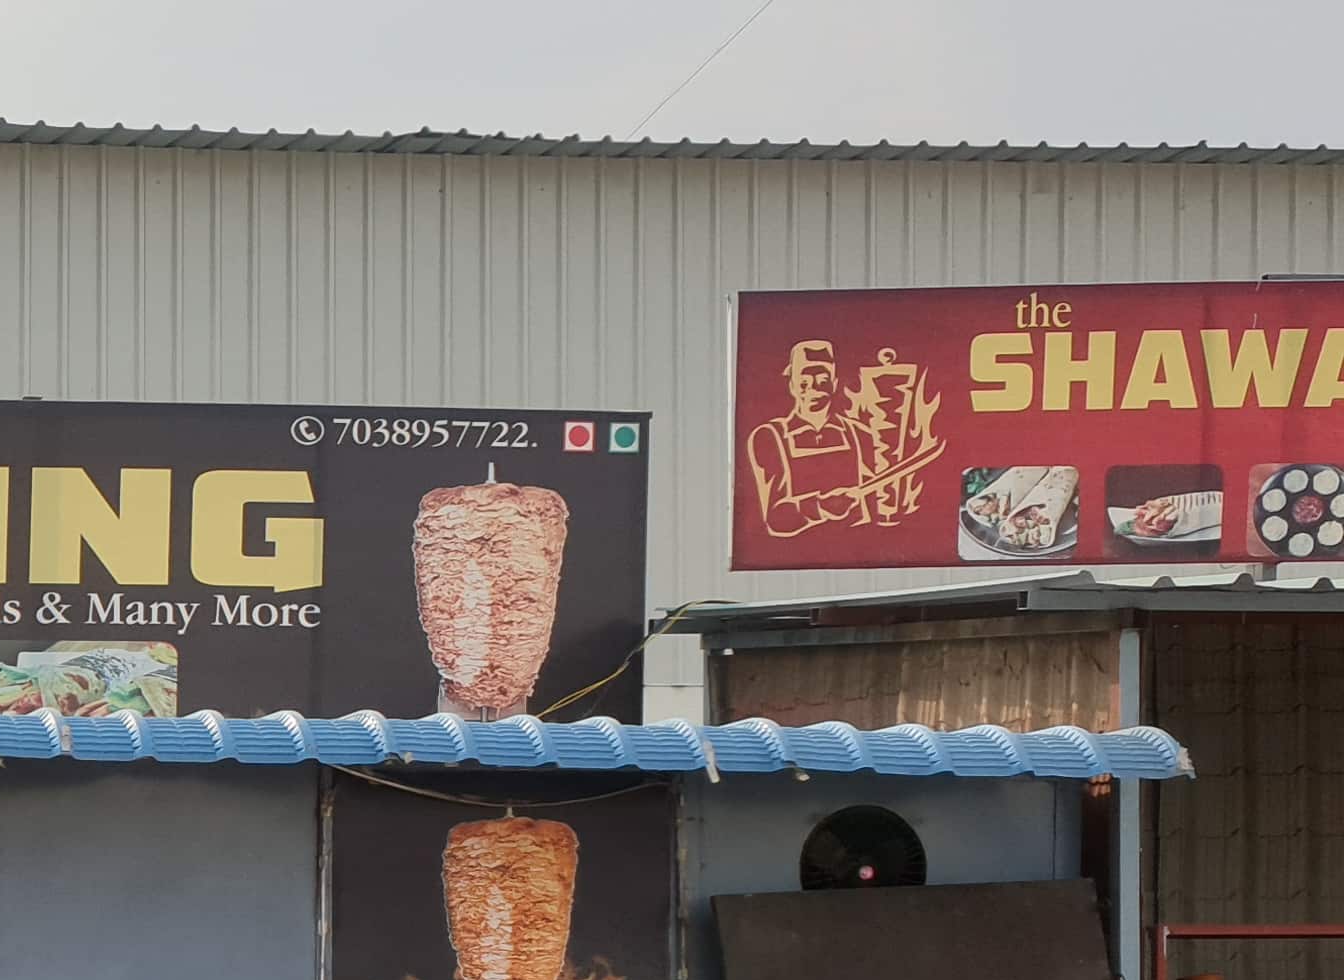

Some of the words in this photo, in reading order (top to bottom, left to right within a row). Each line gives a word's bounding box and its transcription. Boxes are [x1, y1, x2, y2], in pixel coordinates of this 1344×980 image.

[1015, 292, 1072, 329] the
[36, 591, 71, 625] &
[84, 592, 201, 635] Many
[211, 593, 321, 628] More
